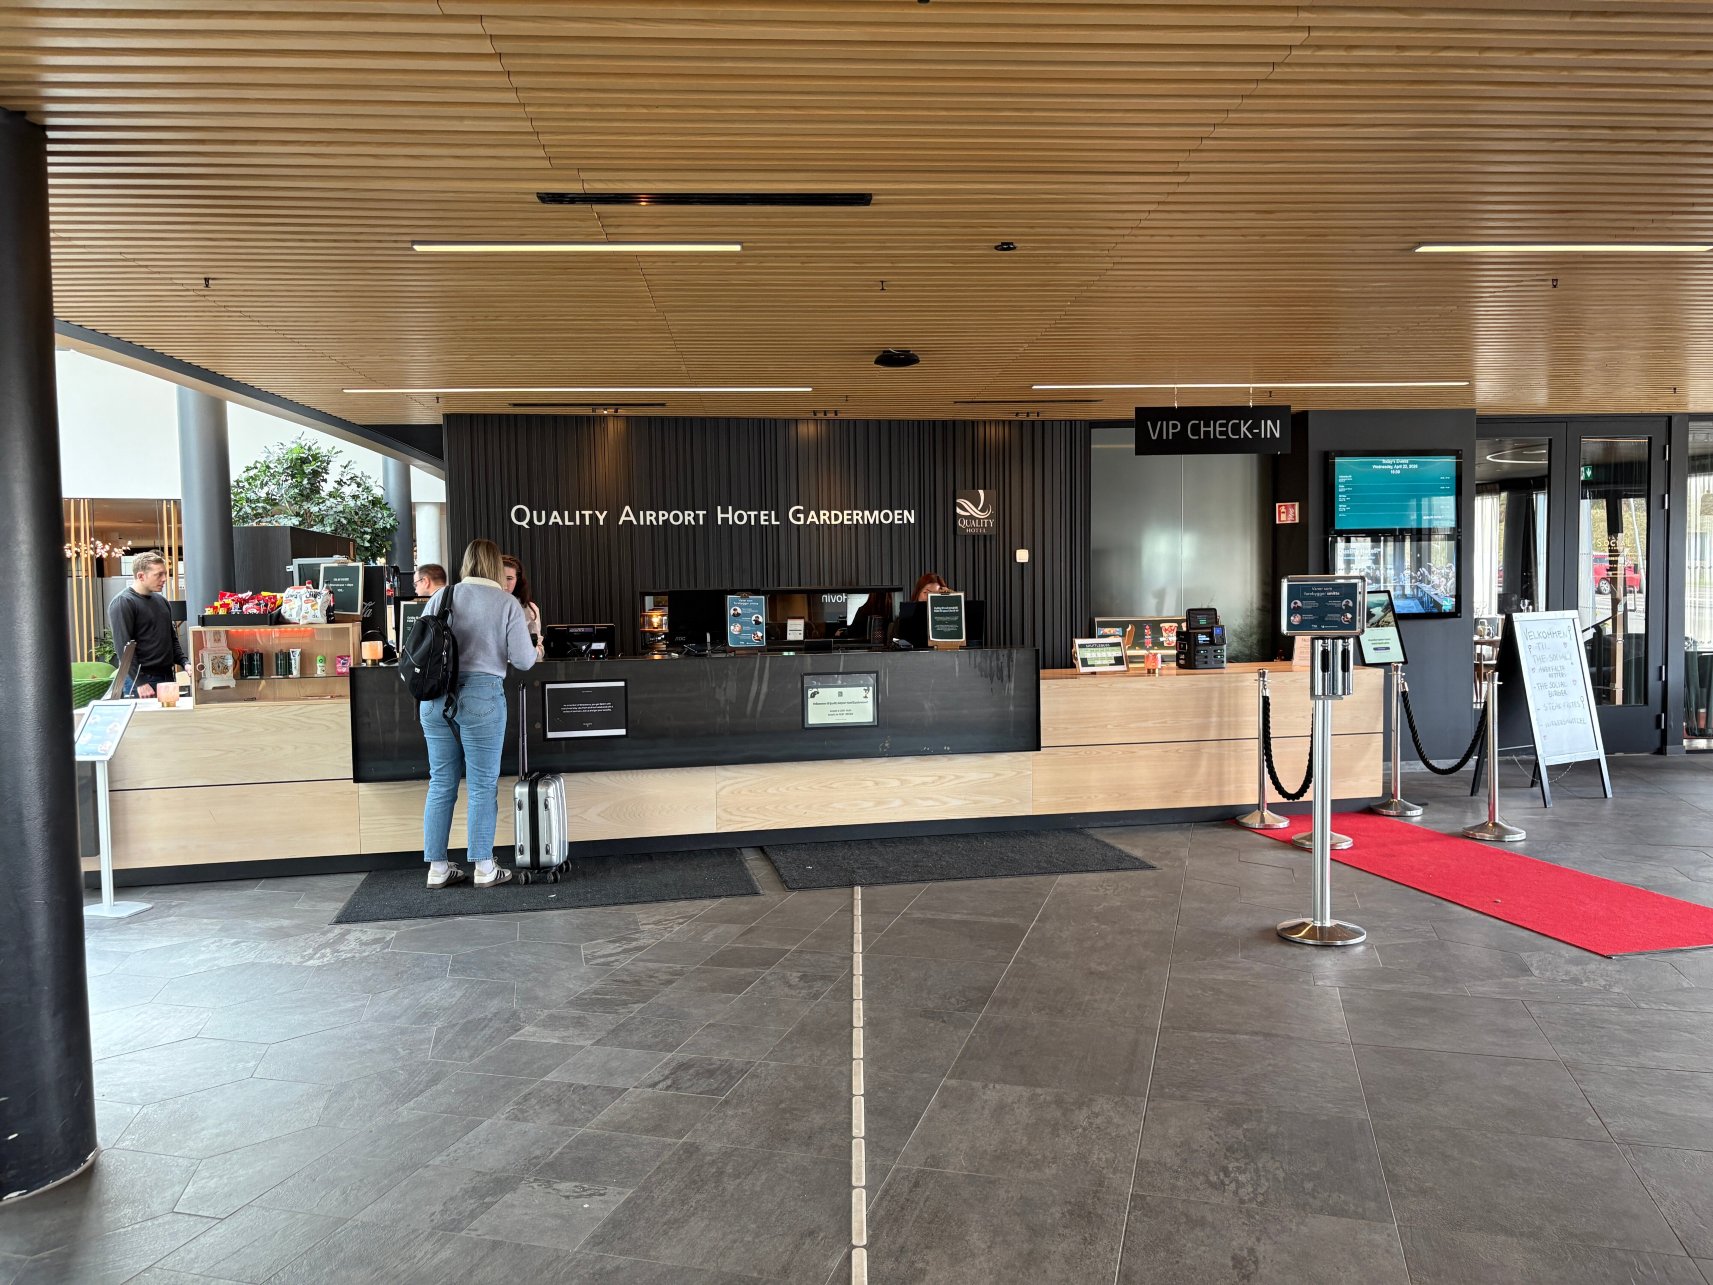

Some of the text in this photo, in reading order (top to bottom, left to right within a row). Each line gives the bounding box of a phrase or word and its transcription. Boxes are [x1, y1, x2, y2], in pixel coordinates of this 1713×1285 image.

[1147, 419, 1281, 440] VIP CHECK-IN
[958, 517, 994, 529] QUALITY
[1596, 539, 1632, 547] SOCIAL
